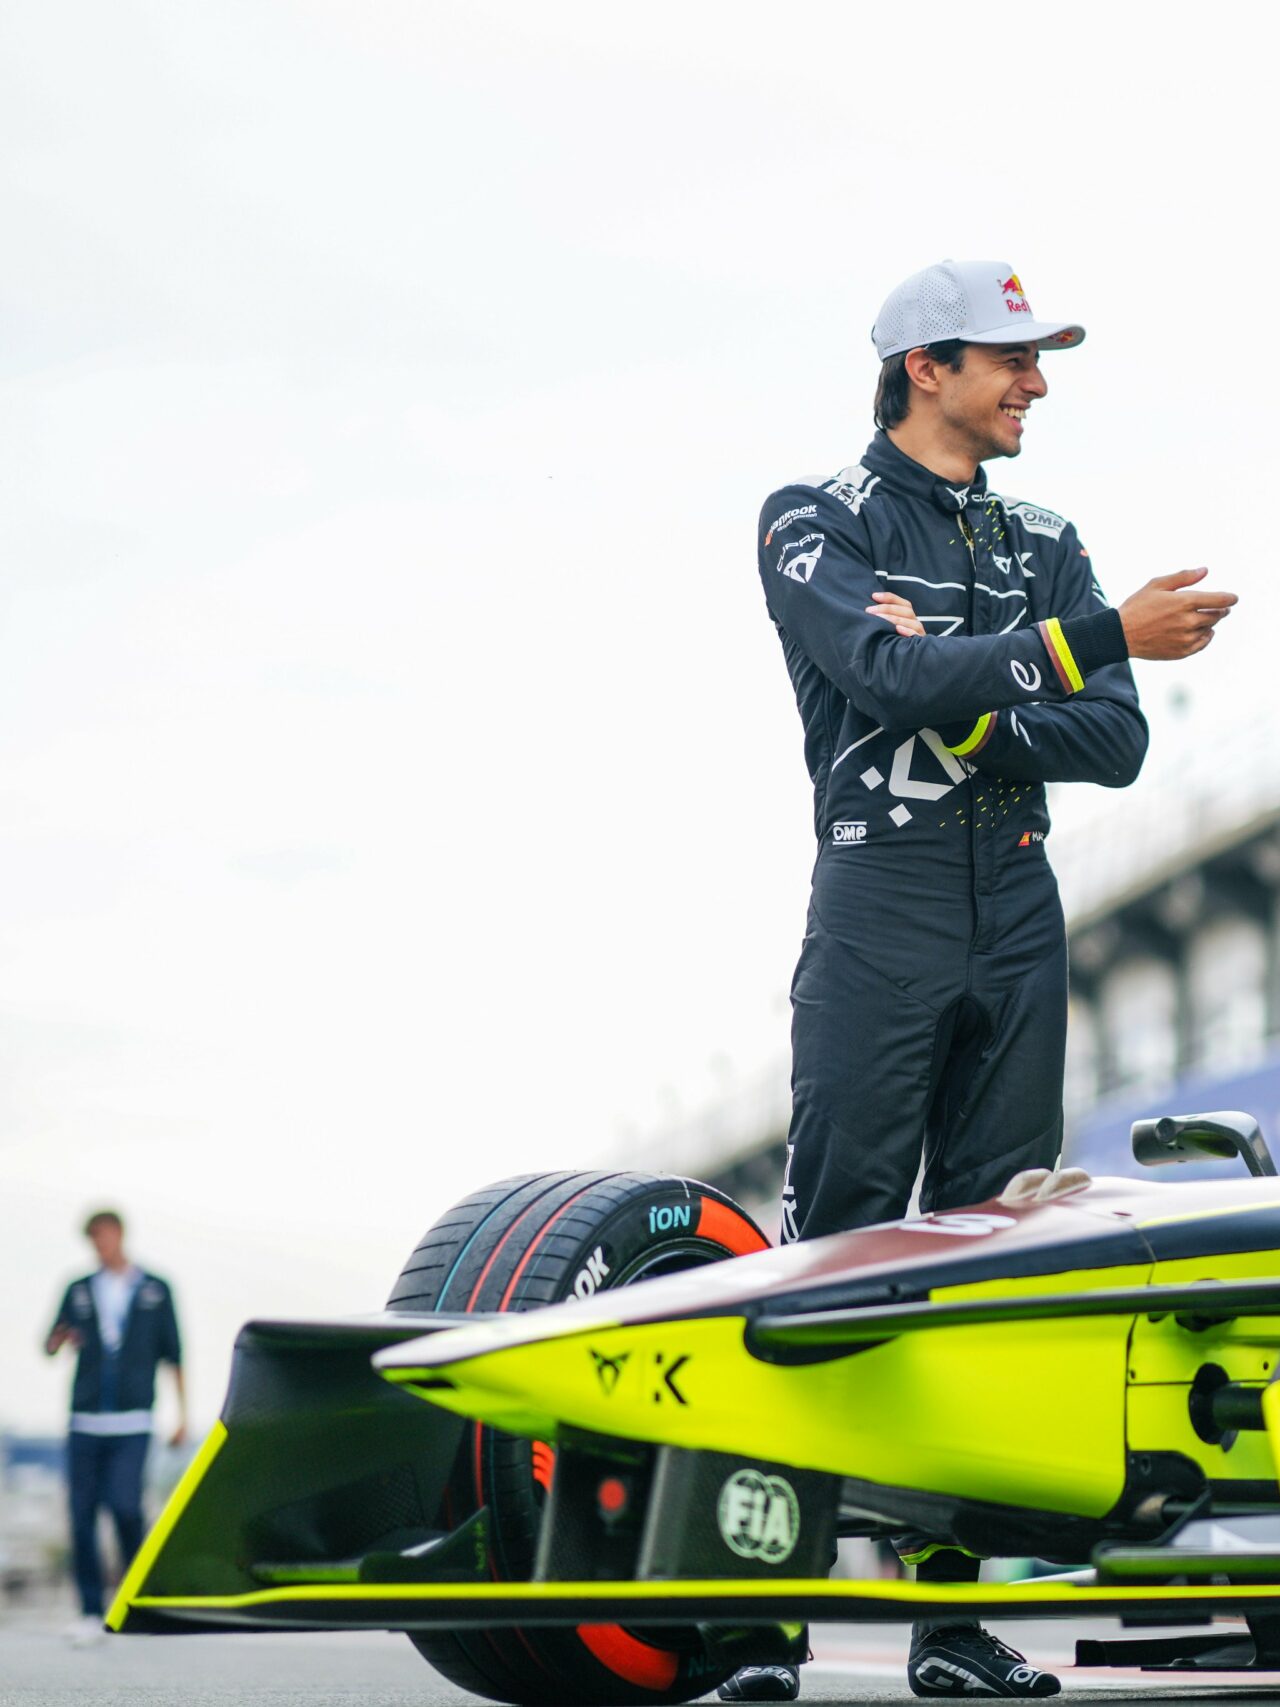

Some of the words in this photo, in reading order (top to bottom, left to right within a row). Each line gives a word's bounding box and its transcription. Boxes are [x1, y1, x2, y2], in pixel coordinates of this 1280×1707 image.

[1006, 298, 1029, 312] Red
[1023, 511, 1064, 528] OMP
[832, 825, 868, 842] OMP
[726, 1486, 792, 1545] FIA
